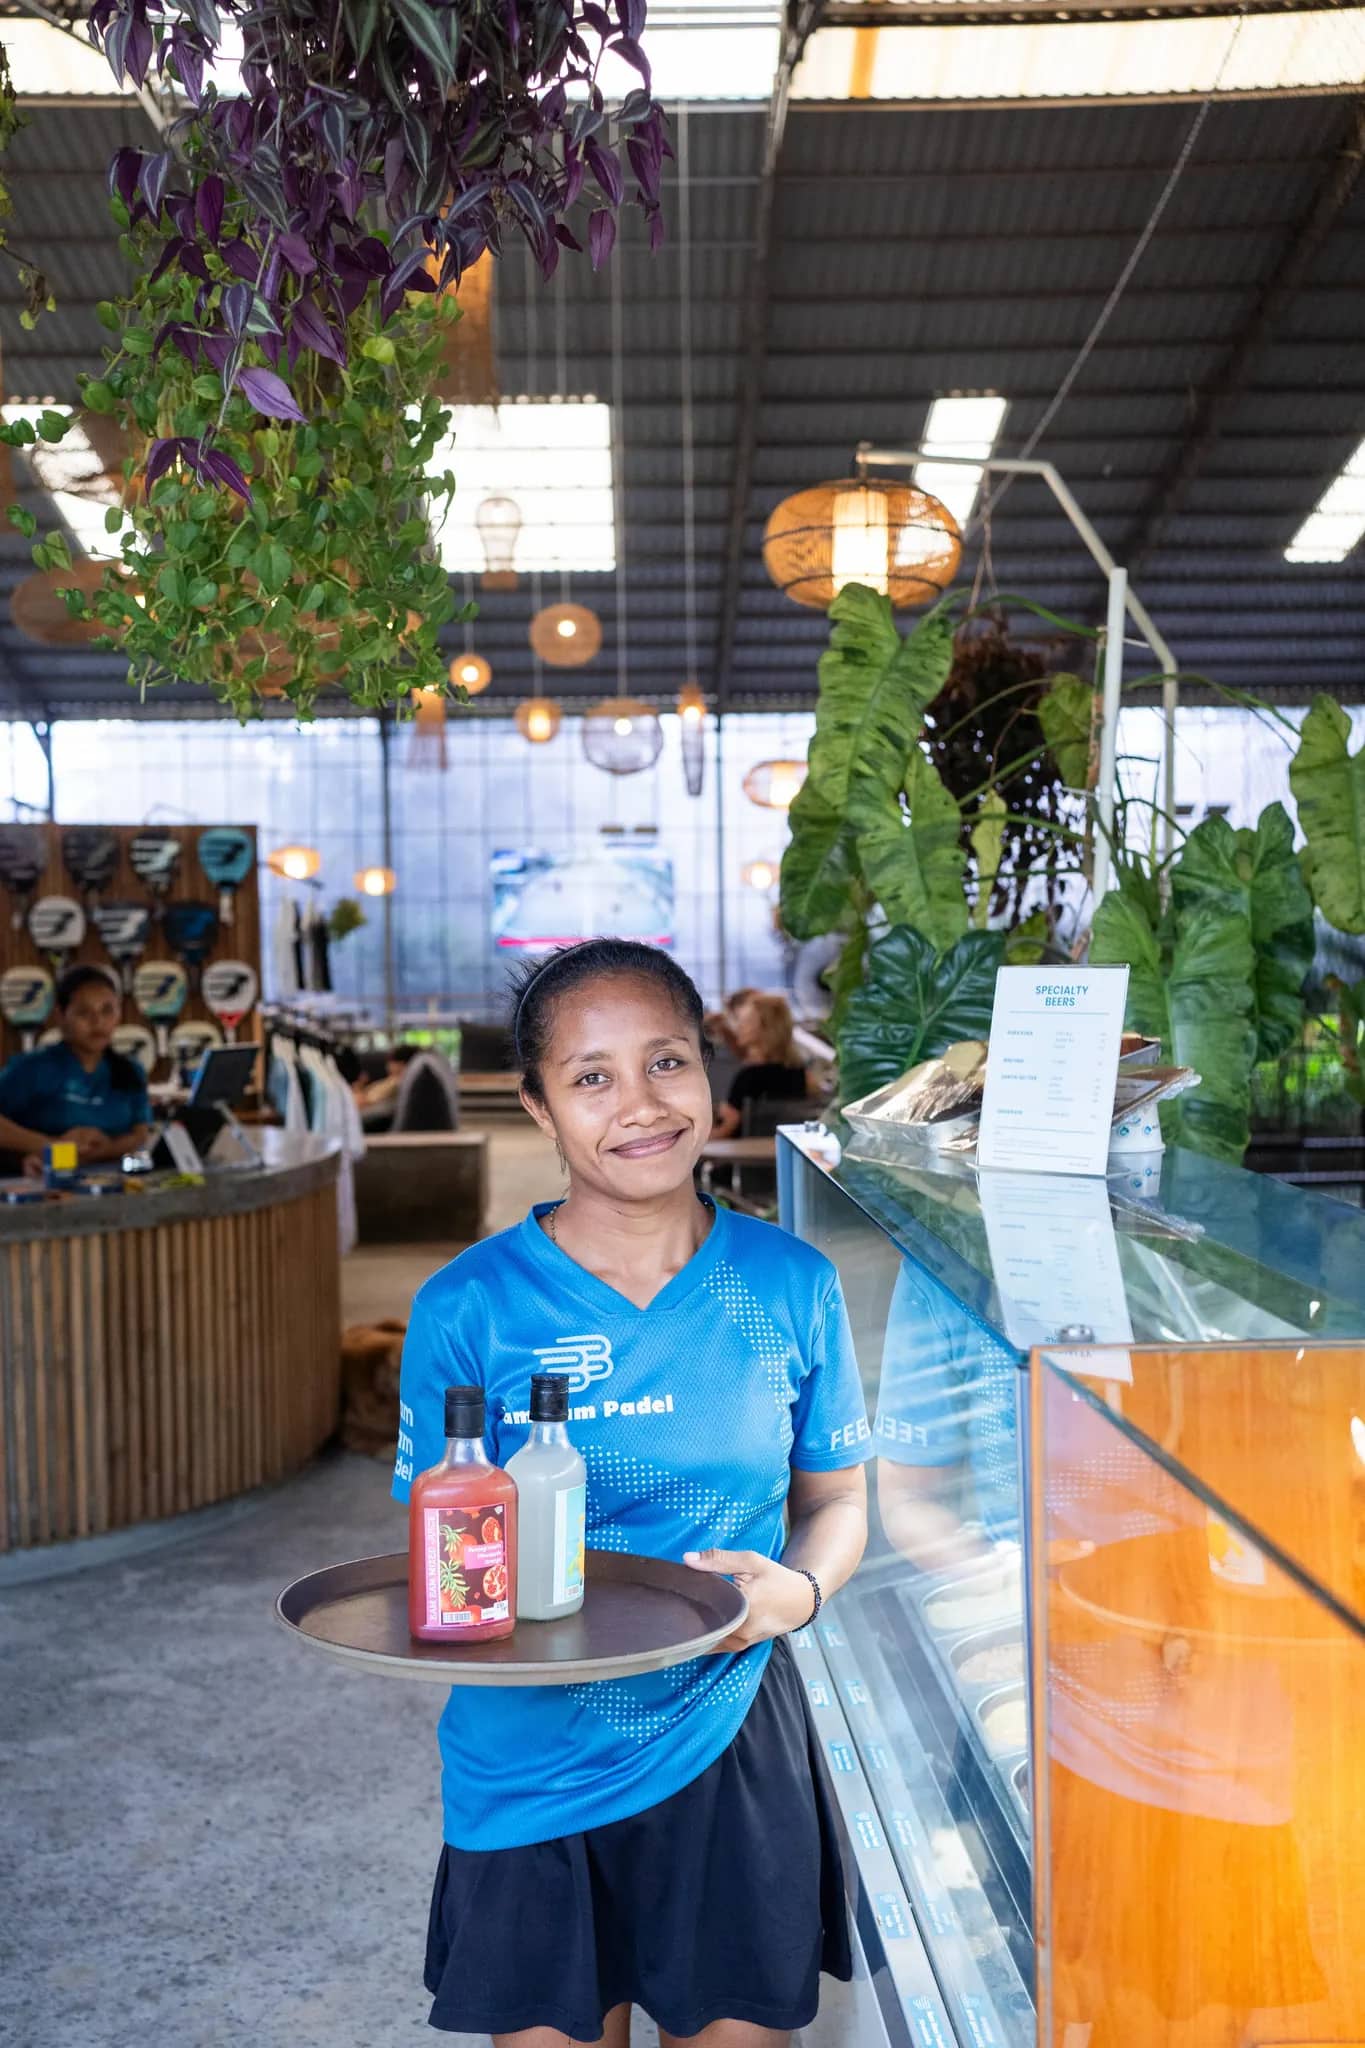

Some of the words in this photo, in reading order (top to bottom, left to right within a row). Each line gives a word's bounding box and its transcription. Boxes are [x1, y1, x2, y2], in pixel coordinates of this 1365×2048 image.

[1035, 985, 1088, 995] SPECIALTY
[1045, 997, 1075, 1006] BEERS
[603, 1394, 674, 1417] Padel
[395, 1456, 413, 1482] del
